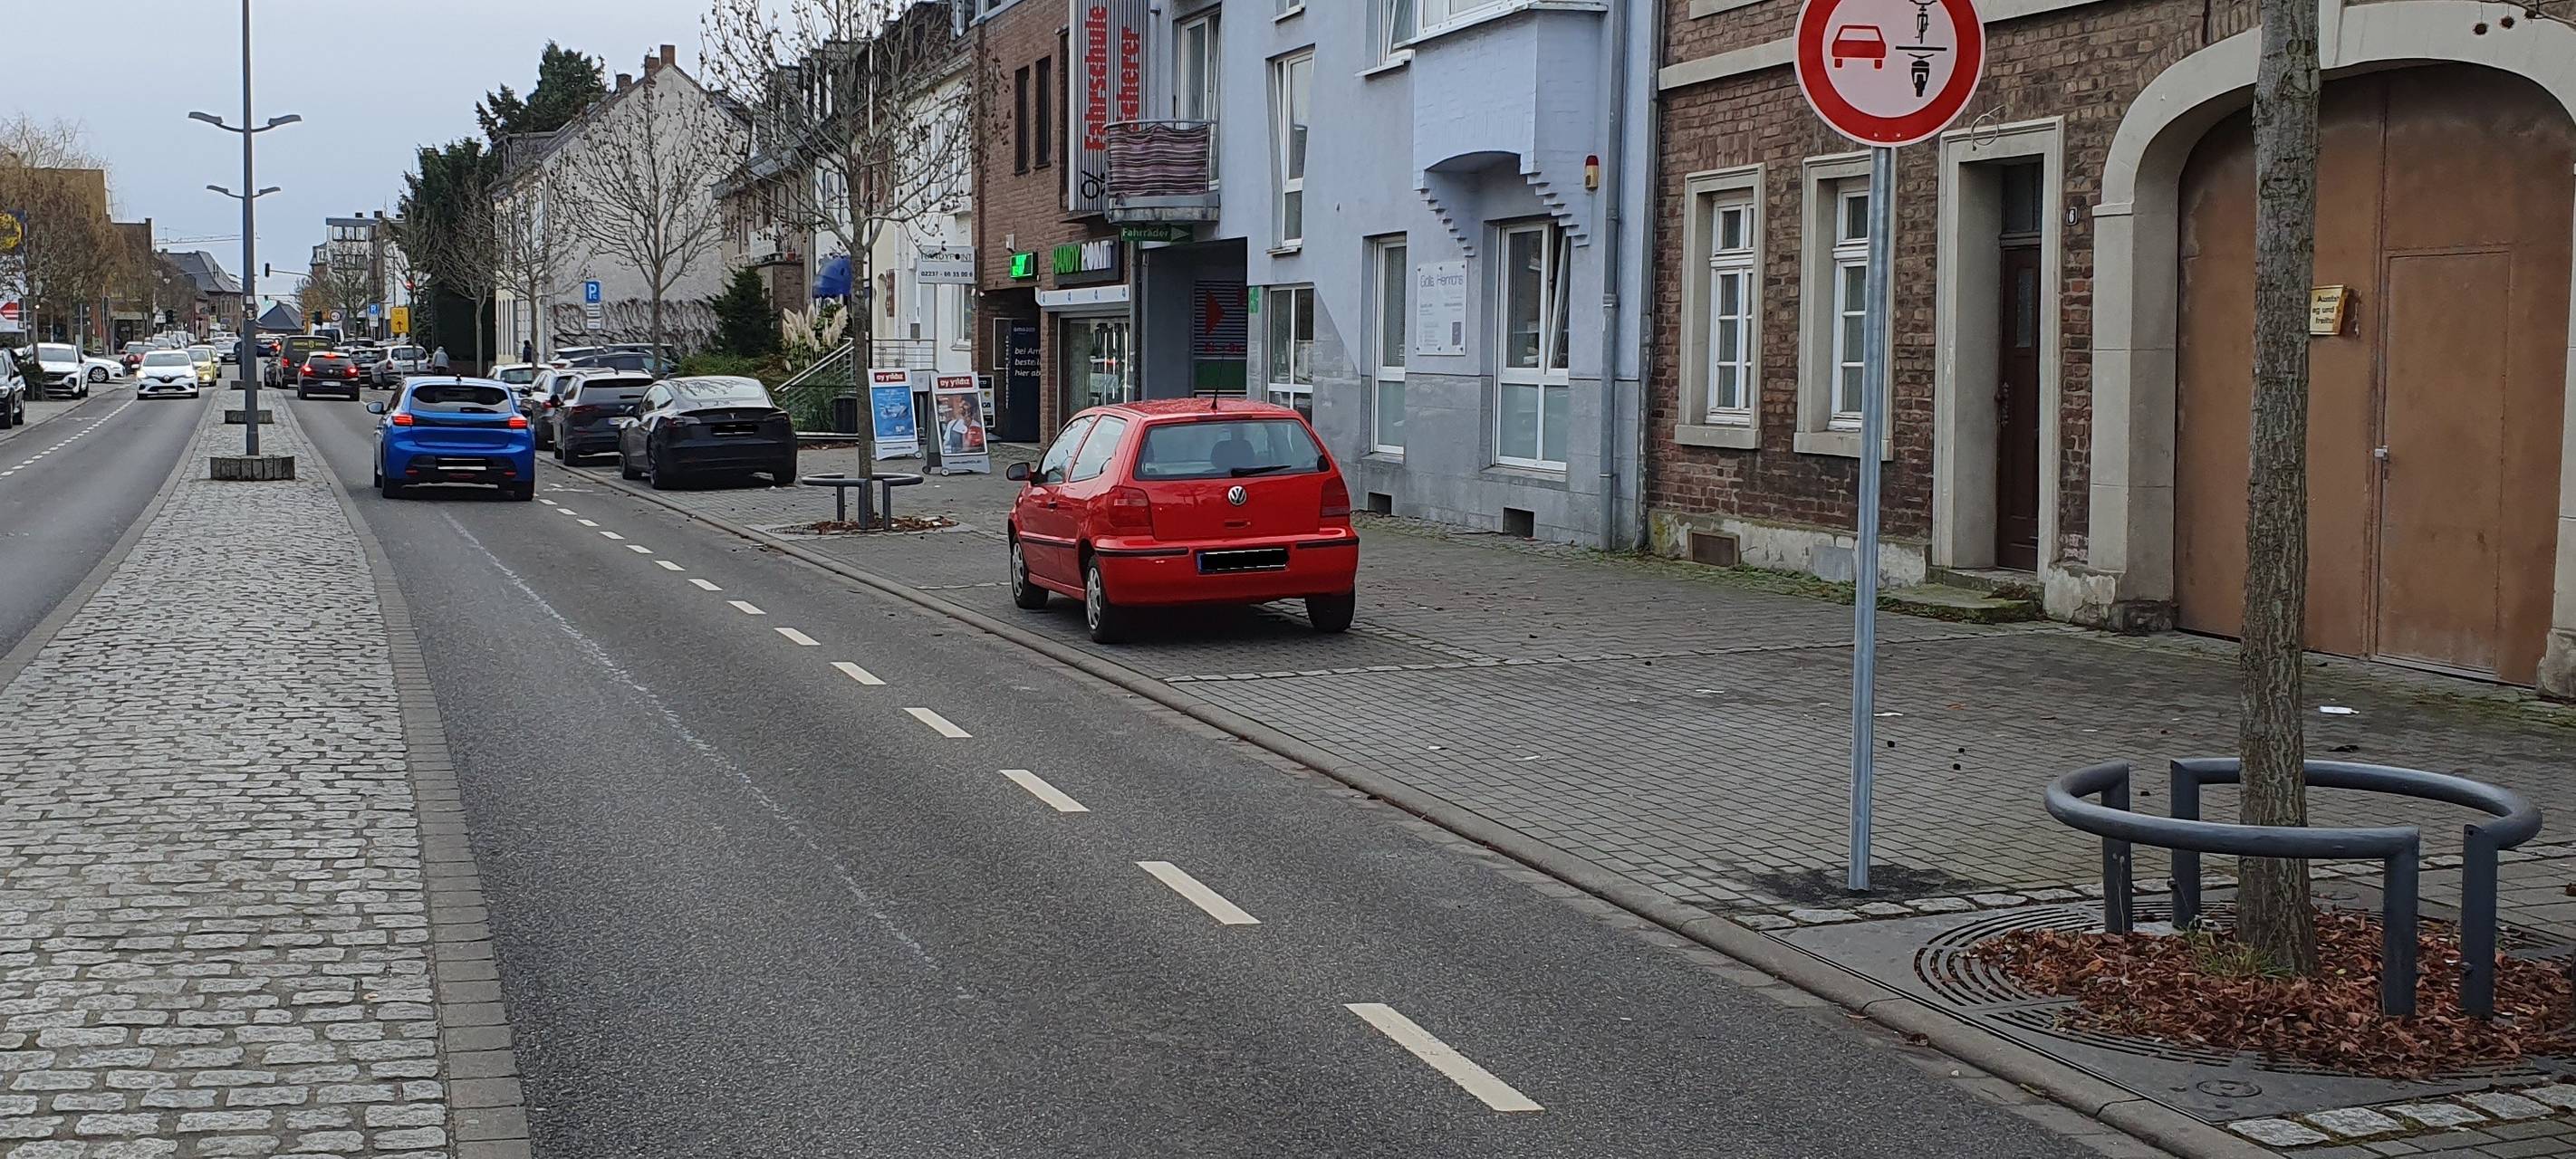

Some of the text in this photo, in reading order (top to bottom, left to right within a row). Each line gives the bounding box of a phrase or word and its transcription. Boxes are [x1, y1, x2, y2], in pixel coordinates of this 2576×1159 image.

[1085, 5, 1107, 151] Fahrschule
[2069, 209, 2074, 223] 6
[1053, 244, 1081, 274] HANDY
